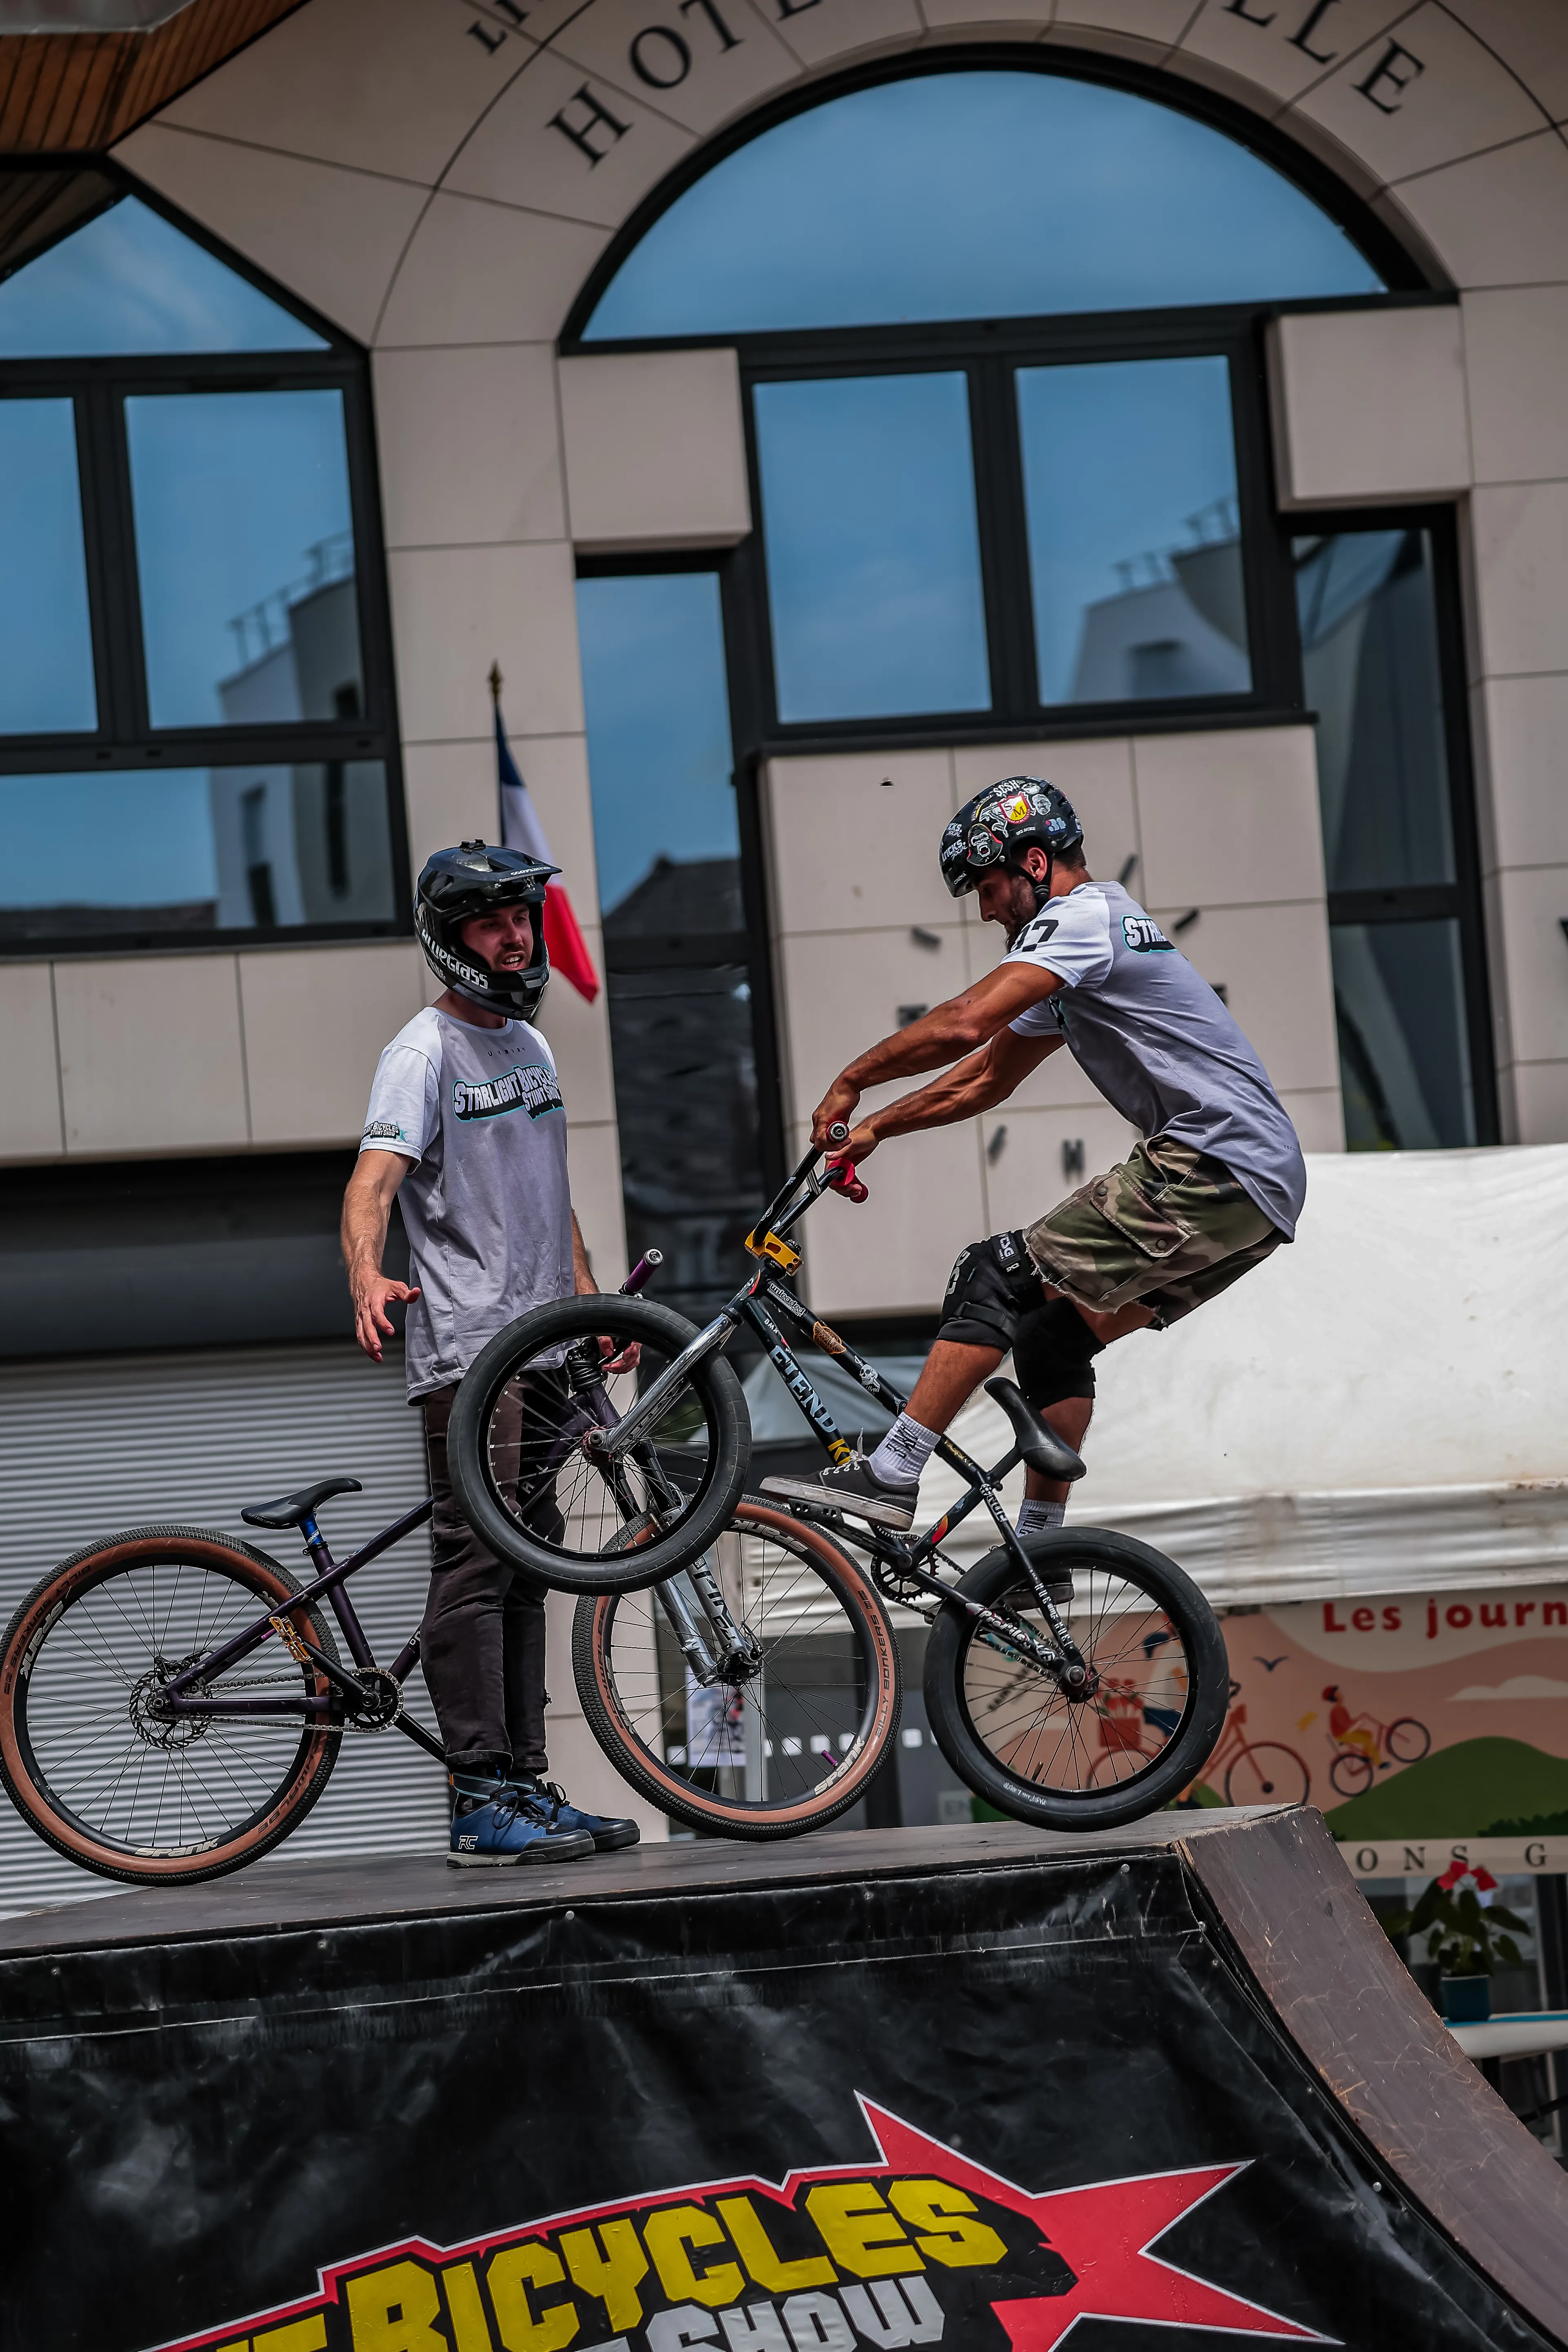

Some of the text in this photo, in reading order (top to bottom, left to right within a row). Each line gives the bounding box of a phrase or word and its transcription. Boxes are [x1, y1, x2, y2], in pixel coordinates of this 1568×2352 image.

[373, 1122, 399, 1133] BICYCLES
[454, 1073, 521, 1113] STARLIGHT
[521, 1086, 548, 1111] STUNT
[770, 1283, 806, 1315] unleaded
[769, 1344, 837, 1433] FIEND
[10, 1564, 91, 1668] BILLY BONKERS
[1323, 1601, 1402, 1633] Les
[597, 1605, 624, 1730] SCHWALBE
[870, 1615, 891, 1739] BILLY BONKERS
[346, 2180, 1009, 2352] BICYCLES
[645, 2275, 945, 2352] SHOW
